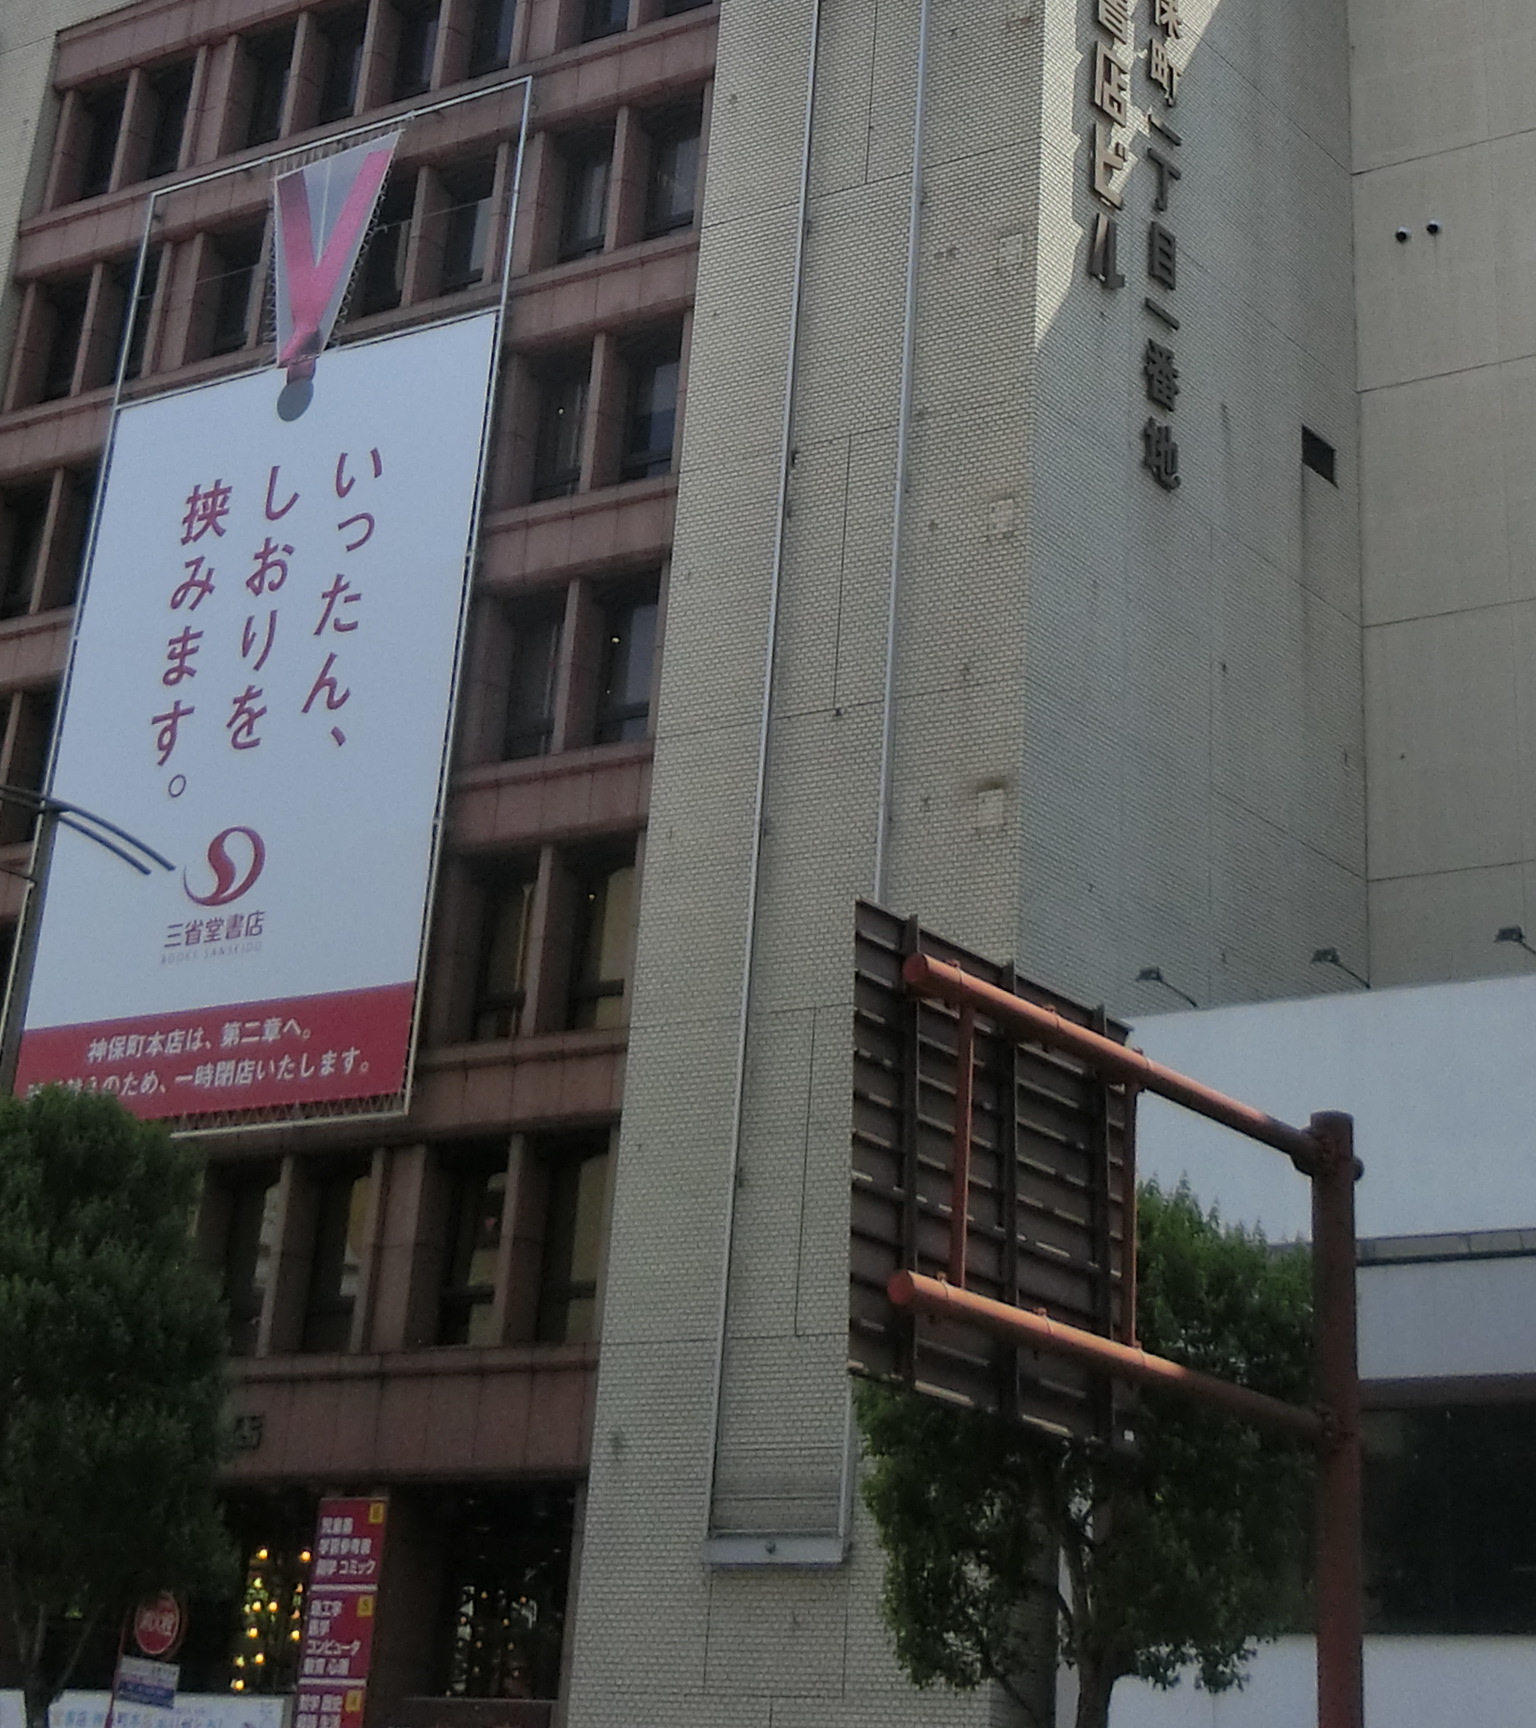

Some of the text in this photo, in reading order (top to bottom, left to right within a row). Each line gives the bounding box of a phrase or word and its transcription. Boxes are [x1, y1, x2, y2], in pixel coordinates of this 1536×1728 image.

[225, 463, 298, 750] しおりを
[301, 447, 384, 747] いったん、
[151, 481, 232, 799] 挟みます。
[163, 910, 266, 948] 三省堂書店
[87, 1017, 312, 1063] 神保町本店は、第二章へ。
[27, 1047, 371, 1097] のため、一時閉店いたします。
[338, 1558, 376, 1575] コミック
[305, 1638, 362, 1656] コンピュータ
